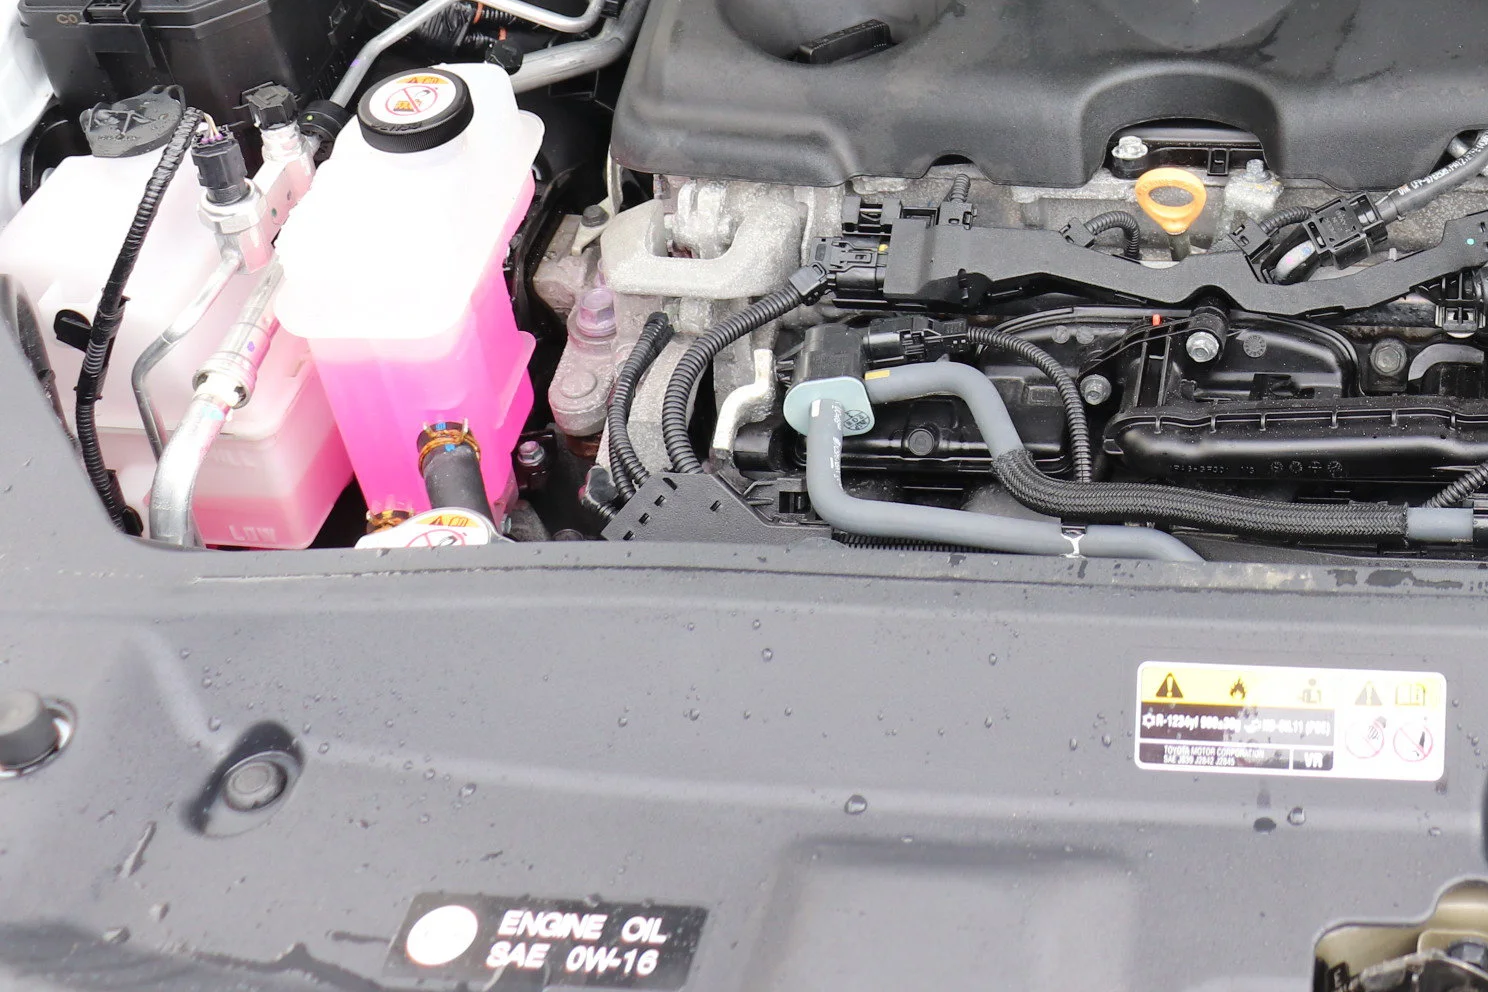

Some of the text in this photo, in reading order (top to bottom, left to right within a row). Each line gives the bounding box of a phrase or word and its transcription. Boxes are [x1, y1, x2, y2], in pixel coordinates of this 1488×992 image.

[1163, 745, 1265, 759] TOYOTA MOTOR CORPORATION
[1163, 755, 1176, 764] SAE
[497, 909, 668, 945] ENGINE OIL
[485, 940, 660, 977] SAE 0W-16
